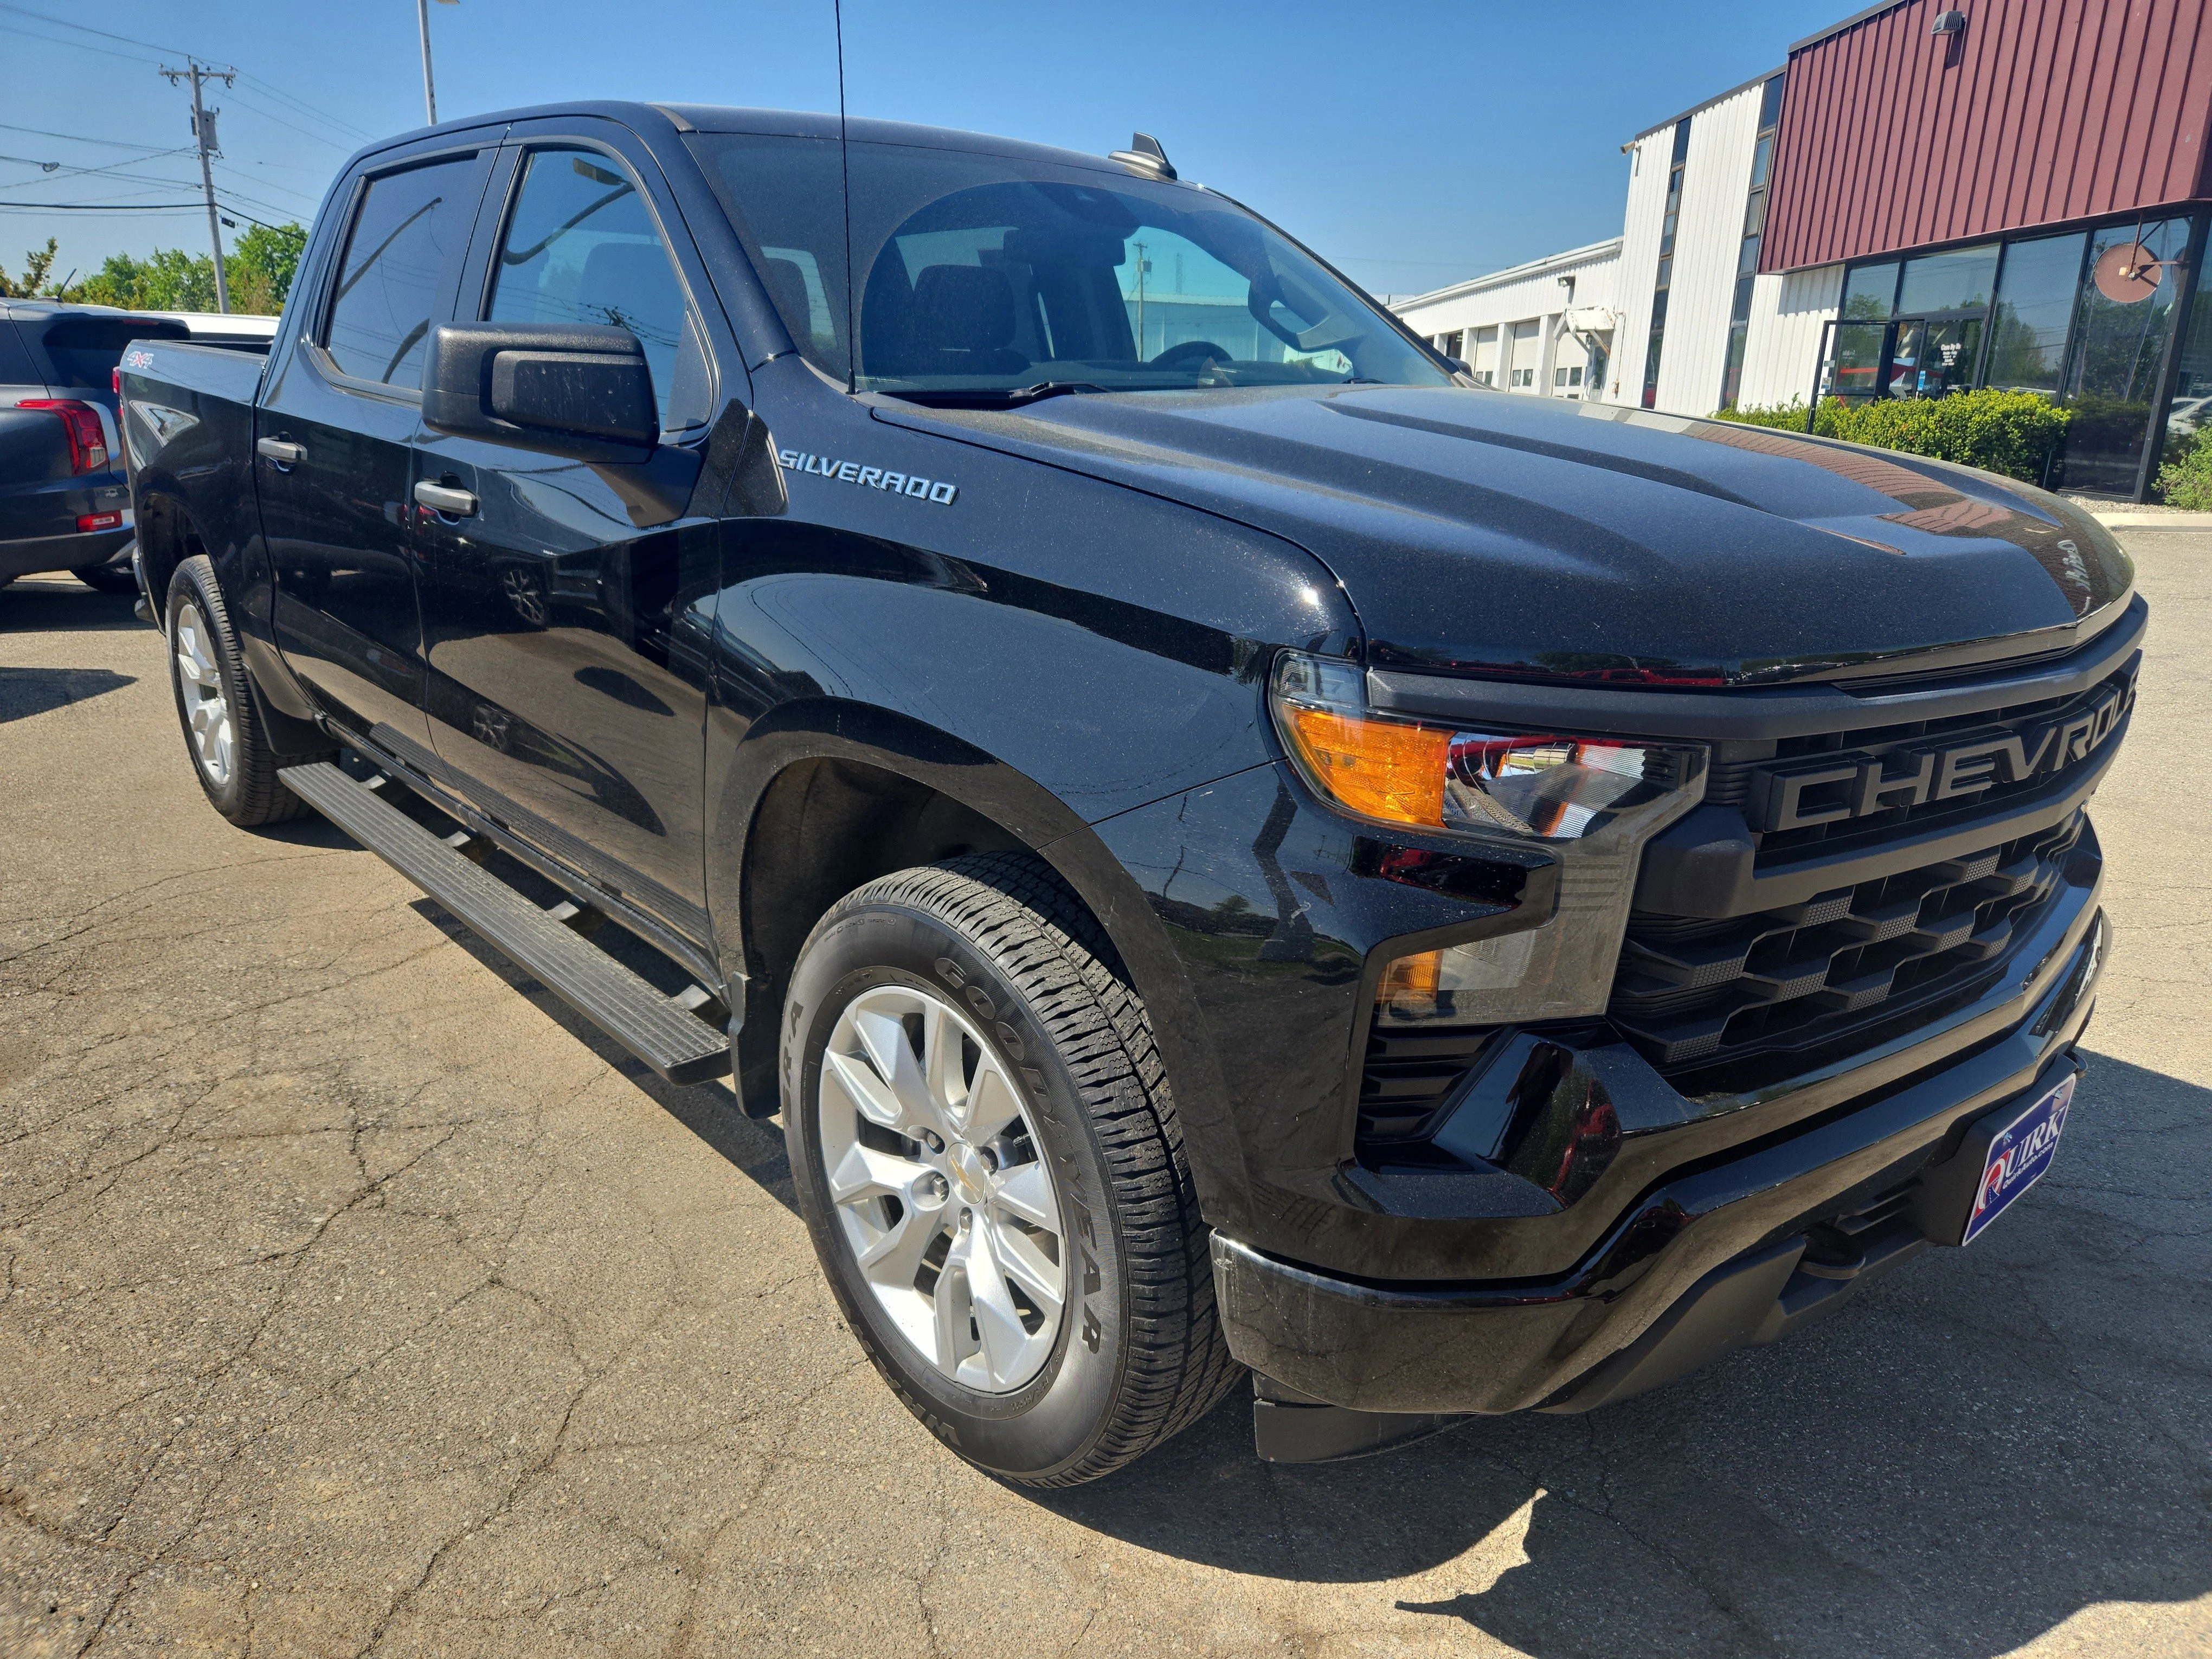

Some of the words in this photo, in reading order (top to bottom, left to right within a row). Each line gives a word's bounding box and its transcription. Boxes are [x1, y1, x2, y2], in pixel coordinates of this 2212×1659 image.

[127, 351, 154, 369] 4X4
[778, 449, 960, 506] SILVERADO
[1764, 648, 2143, 833] CHEVROLE
[934, 957, 1102, 1354] GOODYEAR
[1979, 1105, 2067, 1210] QUIRK
